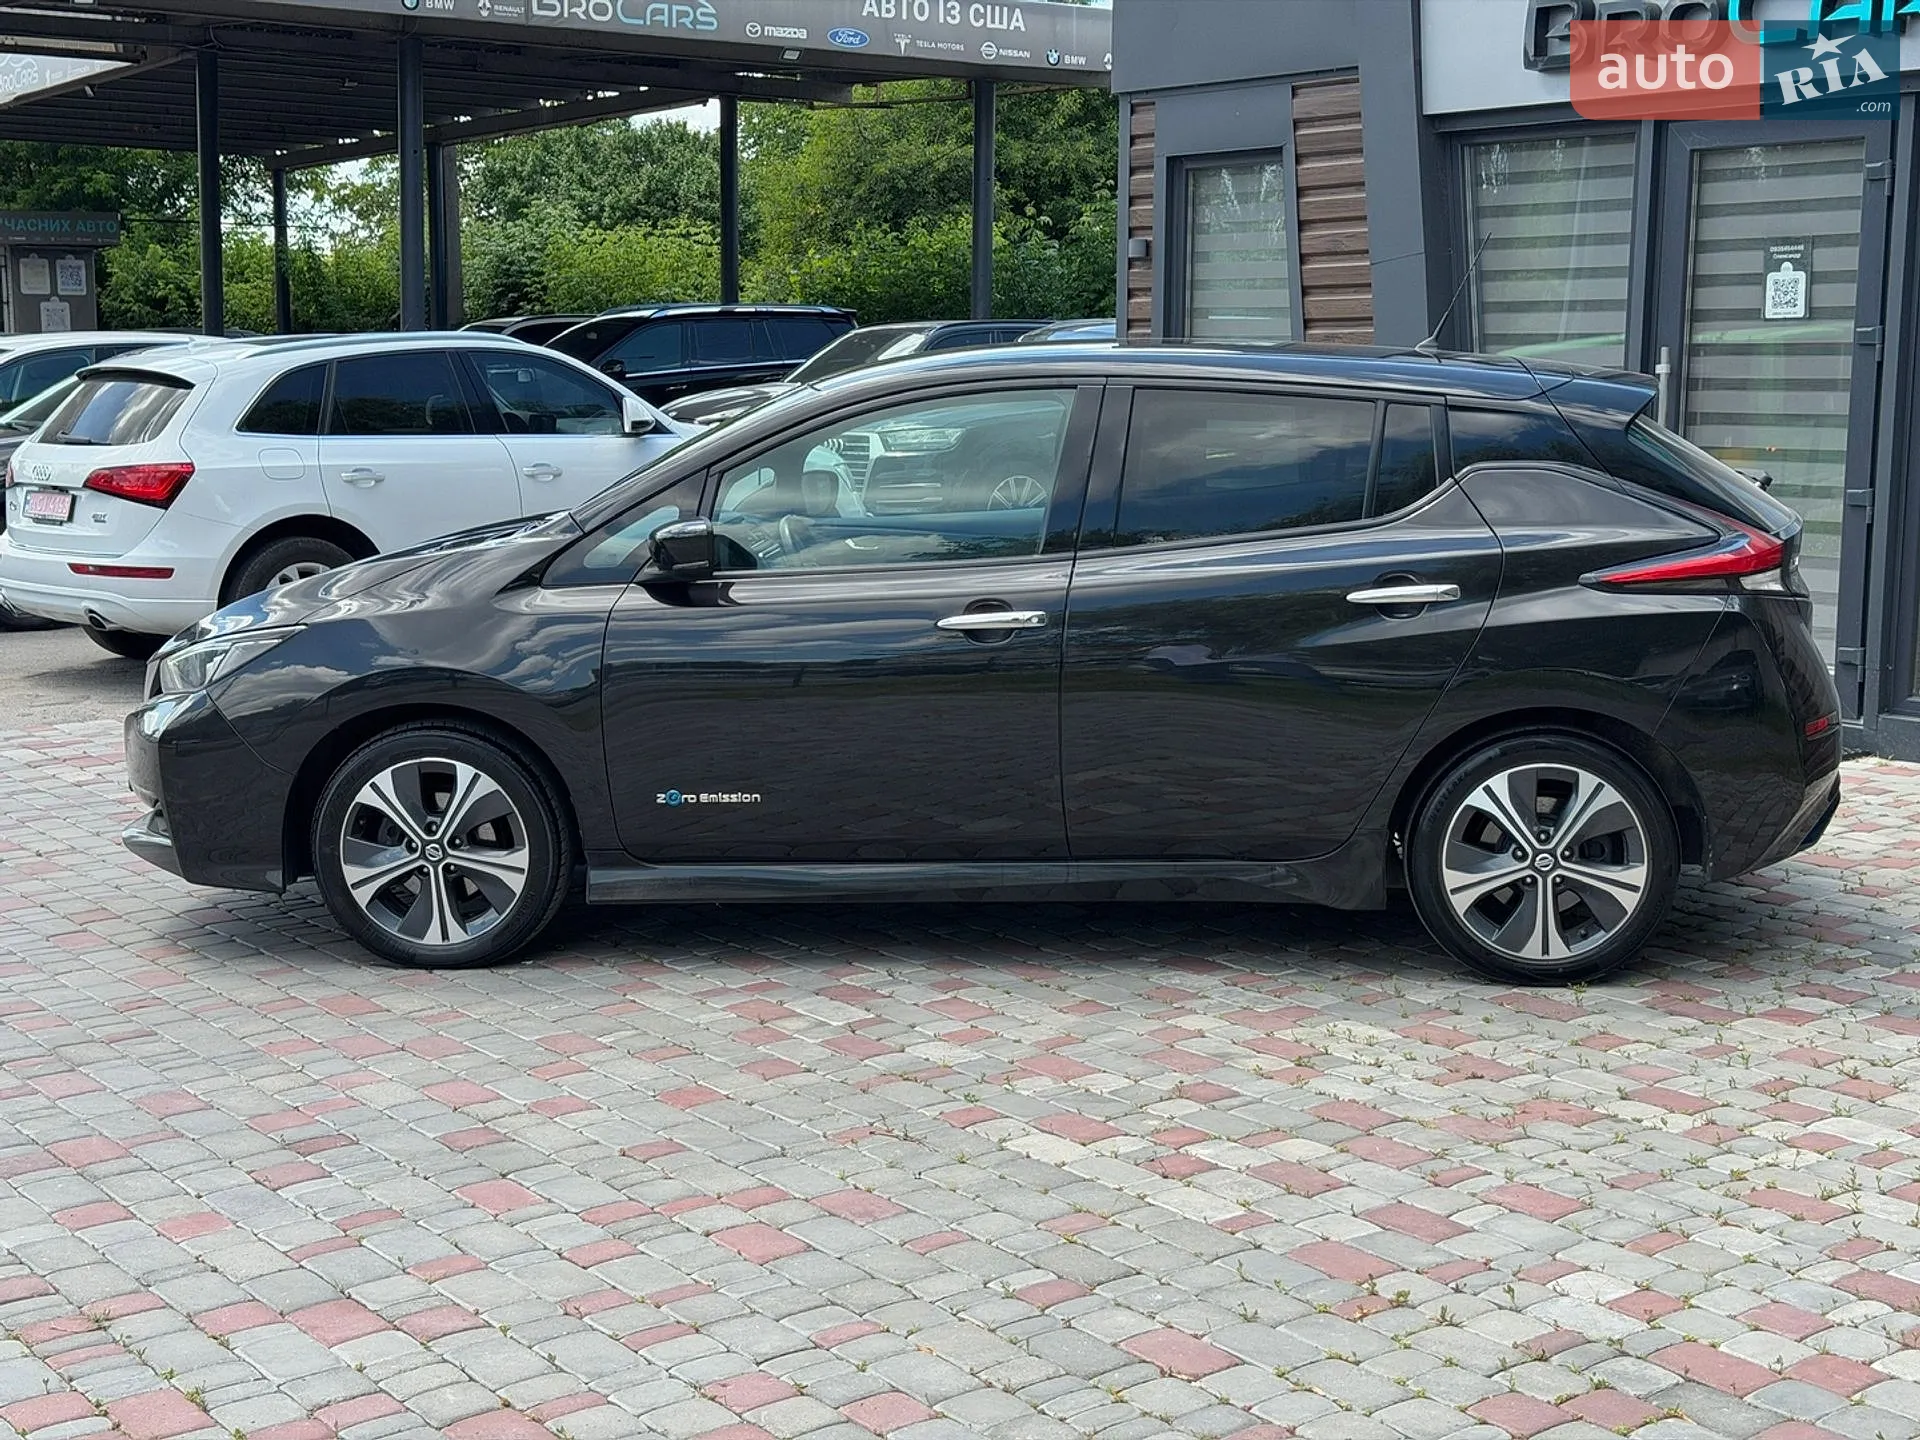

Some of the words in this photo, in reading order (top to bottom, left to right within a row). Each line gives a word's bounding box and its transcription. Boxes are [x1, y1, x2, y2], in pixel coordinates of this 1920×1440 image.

[426, 0, 455, 11] BMW
[862, 0, 930, 22] АВТО
[969, 3, 1026, 32] США
[834, 31, 863, 46] Ford
[915, 40, 936, 49] TESLA
[937, 42, 965, 52] MOTORS
[999, 49, 1031, 59] NISSAN
[1064, 55, 1087, 66] BMW
[0, 218, 71, 232] ЧАСНИХ
[75, 220, 117, 233] АВТО
